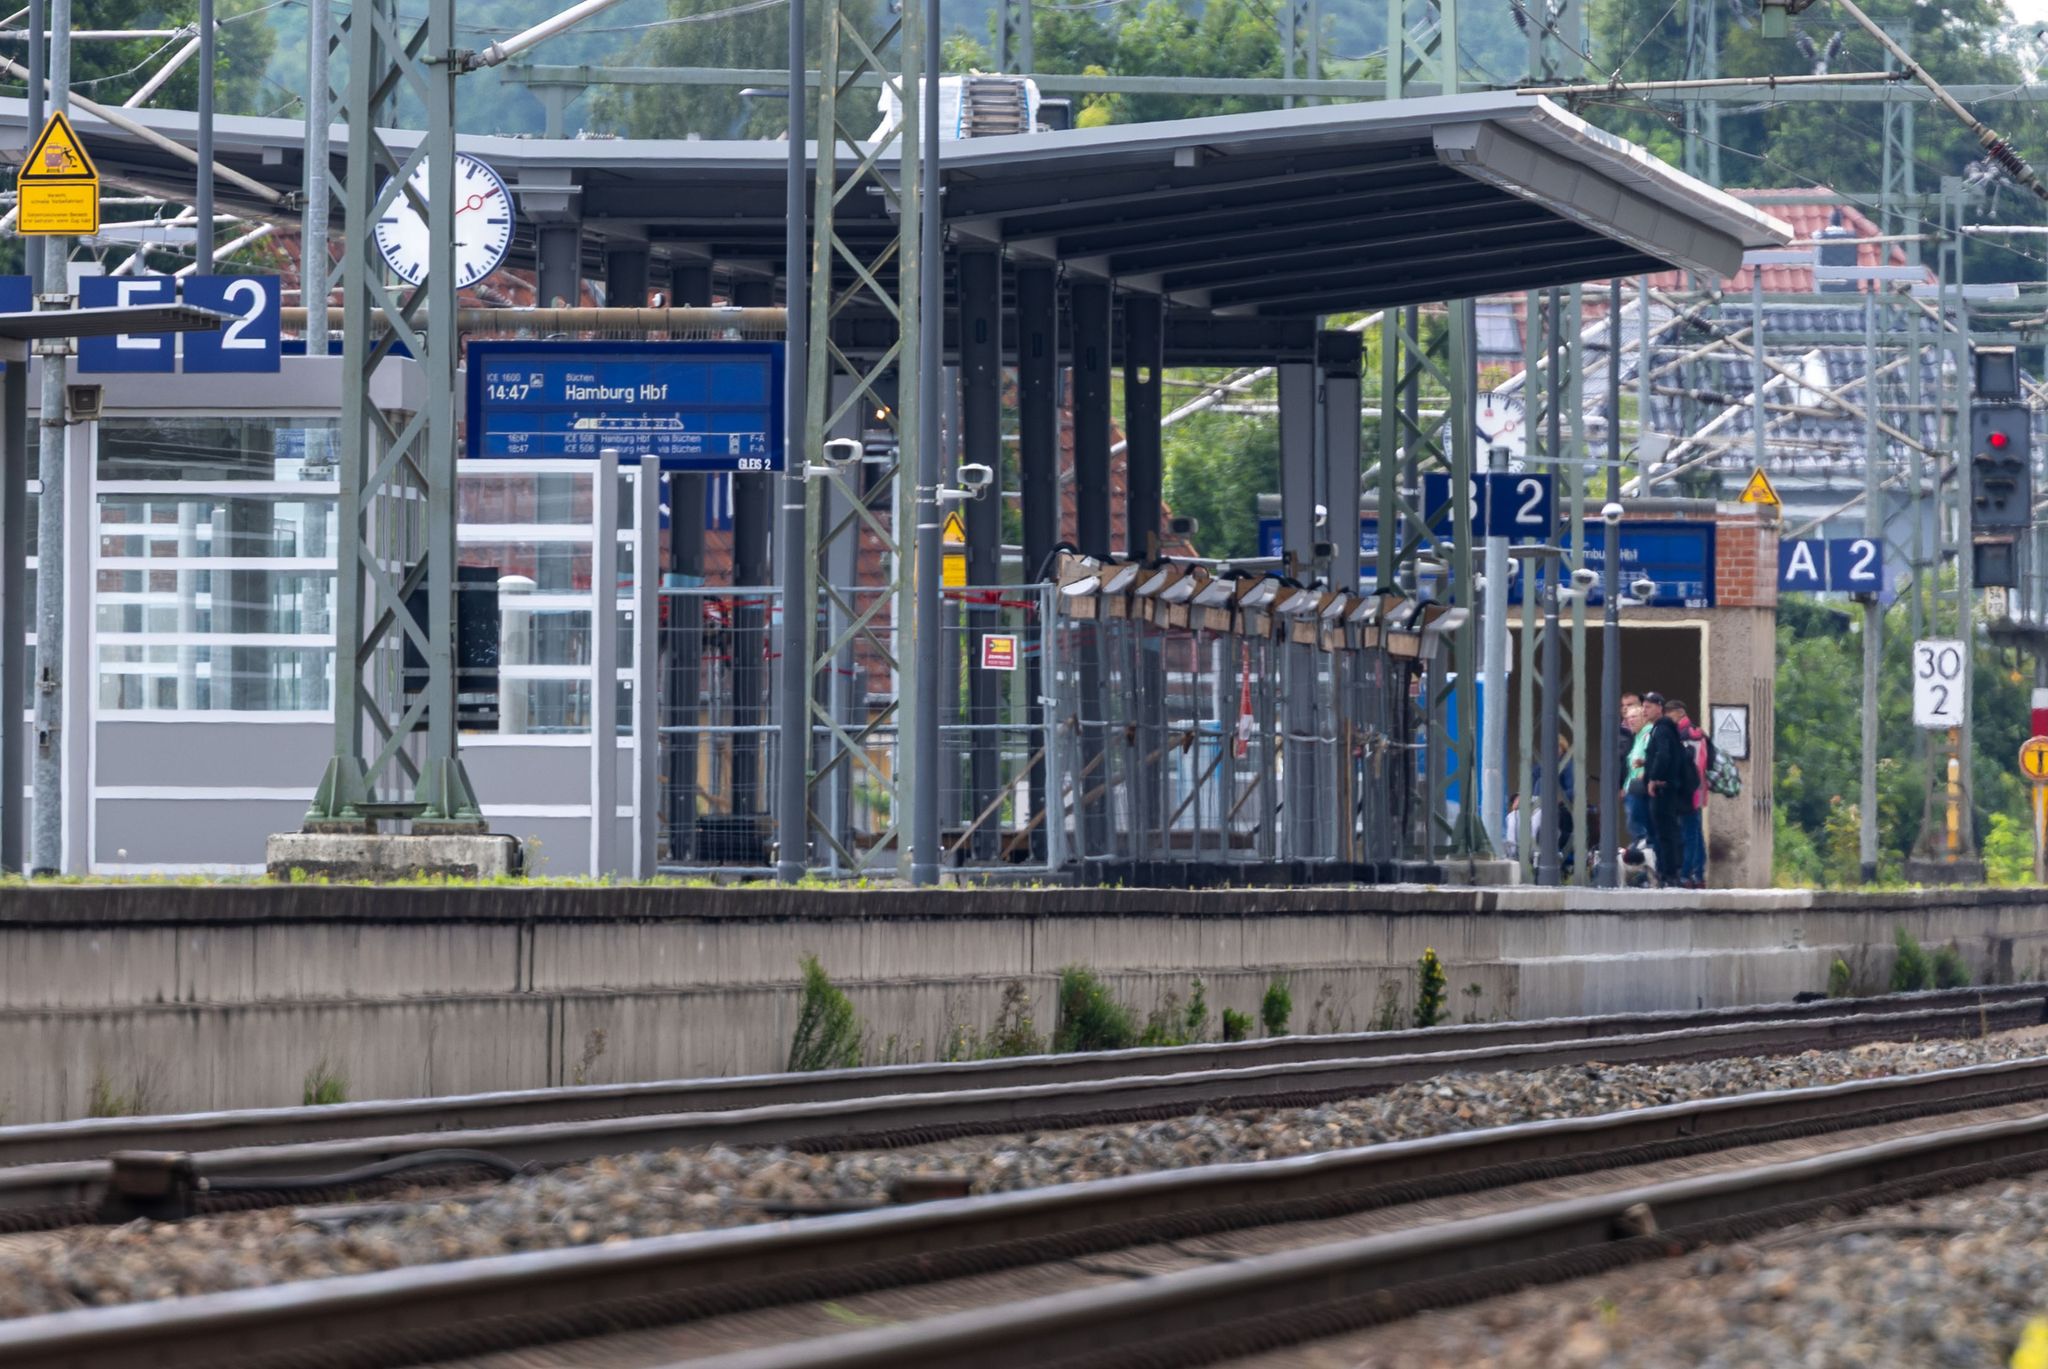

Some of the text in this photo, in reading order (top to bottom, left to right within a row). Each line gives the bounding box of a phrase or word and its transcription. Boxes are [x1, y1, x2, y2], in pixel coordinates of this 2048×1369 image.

[222, 279, 267, 349] 2
[486, 373, 499, 382] ICE
[487, 384, 529, 400] 14:47
[565, 384, 668, 402] Hamburg Hbf
[565, 434, 577, 443] ICE
[636, 434, 651, 443] Hbf
[565, 444, 577, 453] ICE
[738, 458, 772, 470] GLEIS 2
[1515, 478, 1544, 523] 2
[1785, 539, 1876, 580] A 2
[1919, 648, 1961, 680] 30
[1930, 684, 1949, 715] 2
